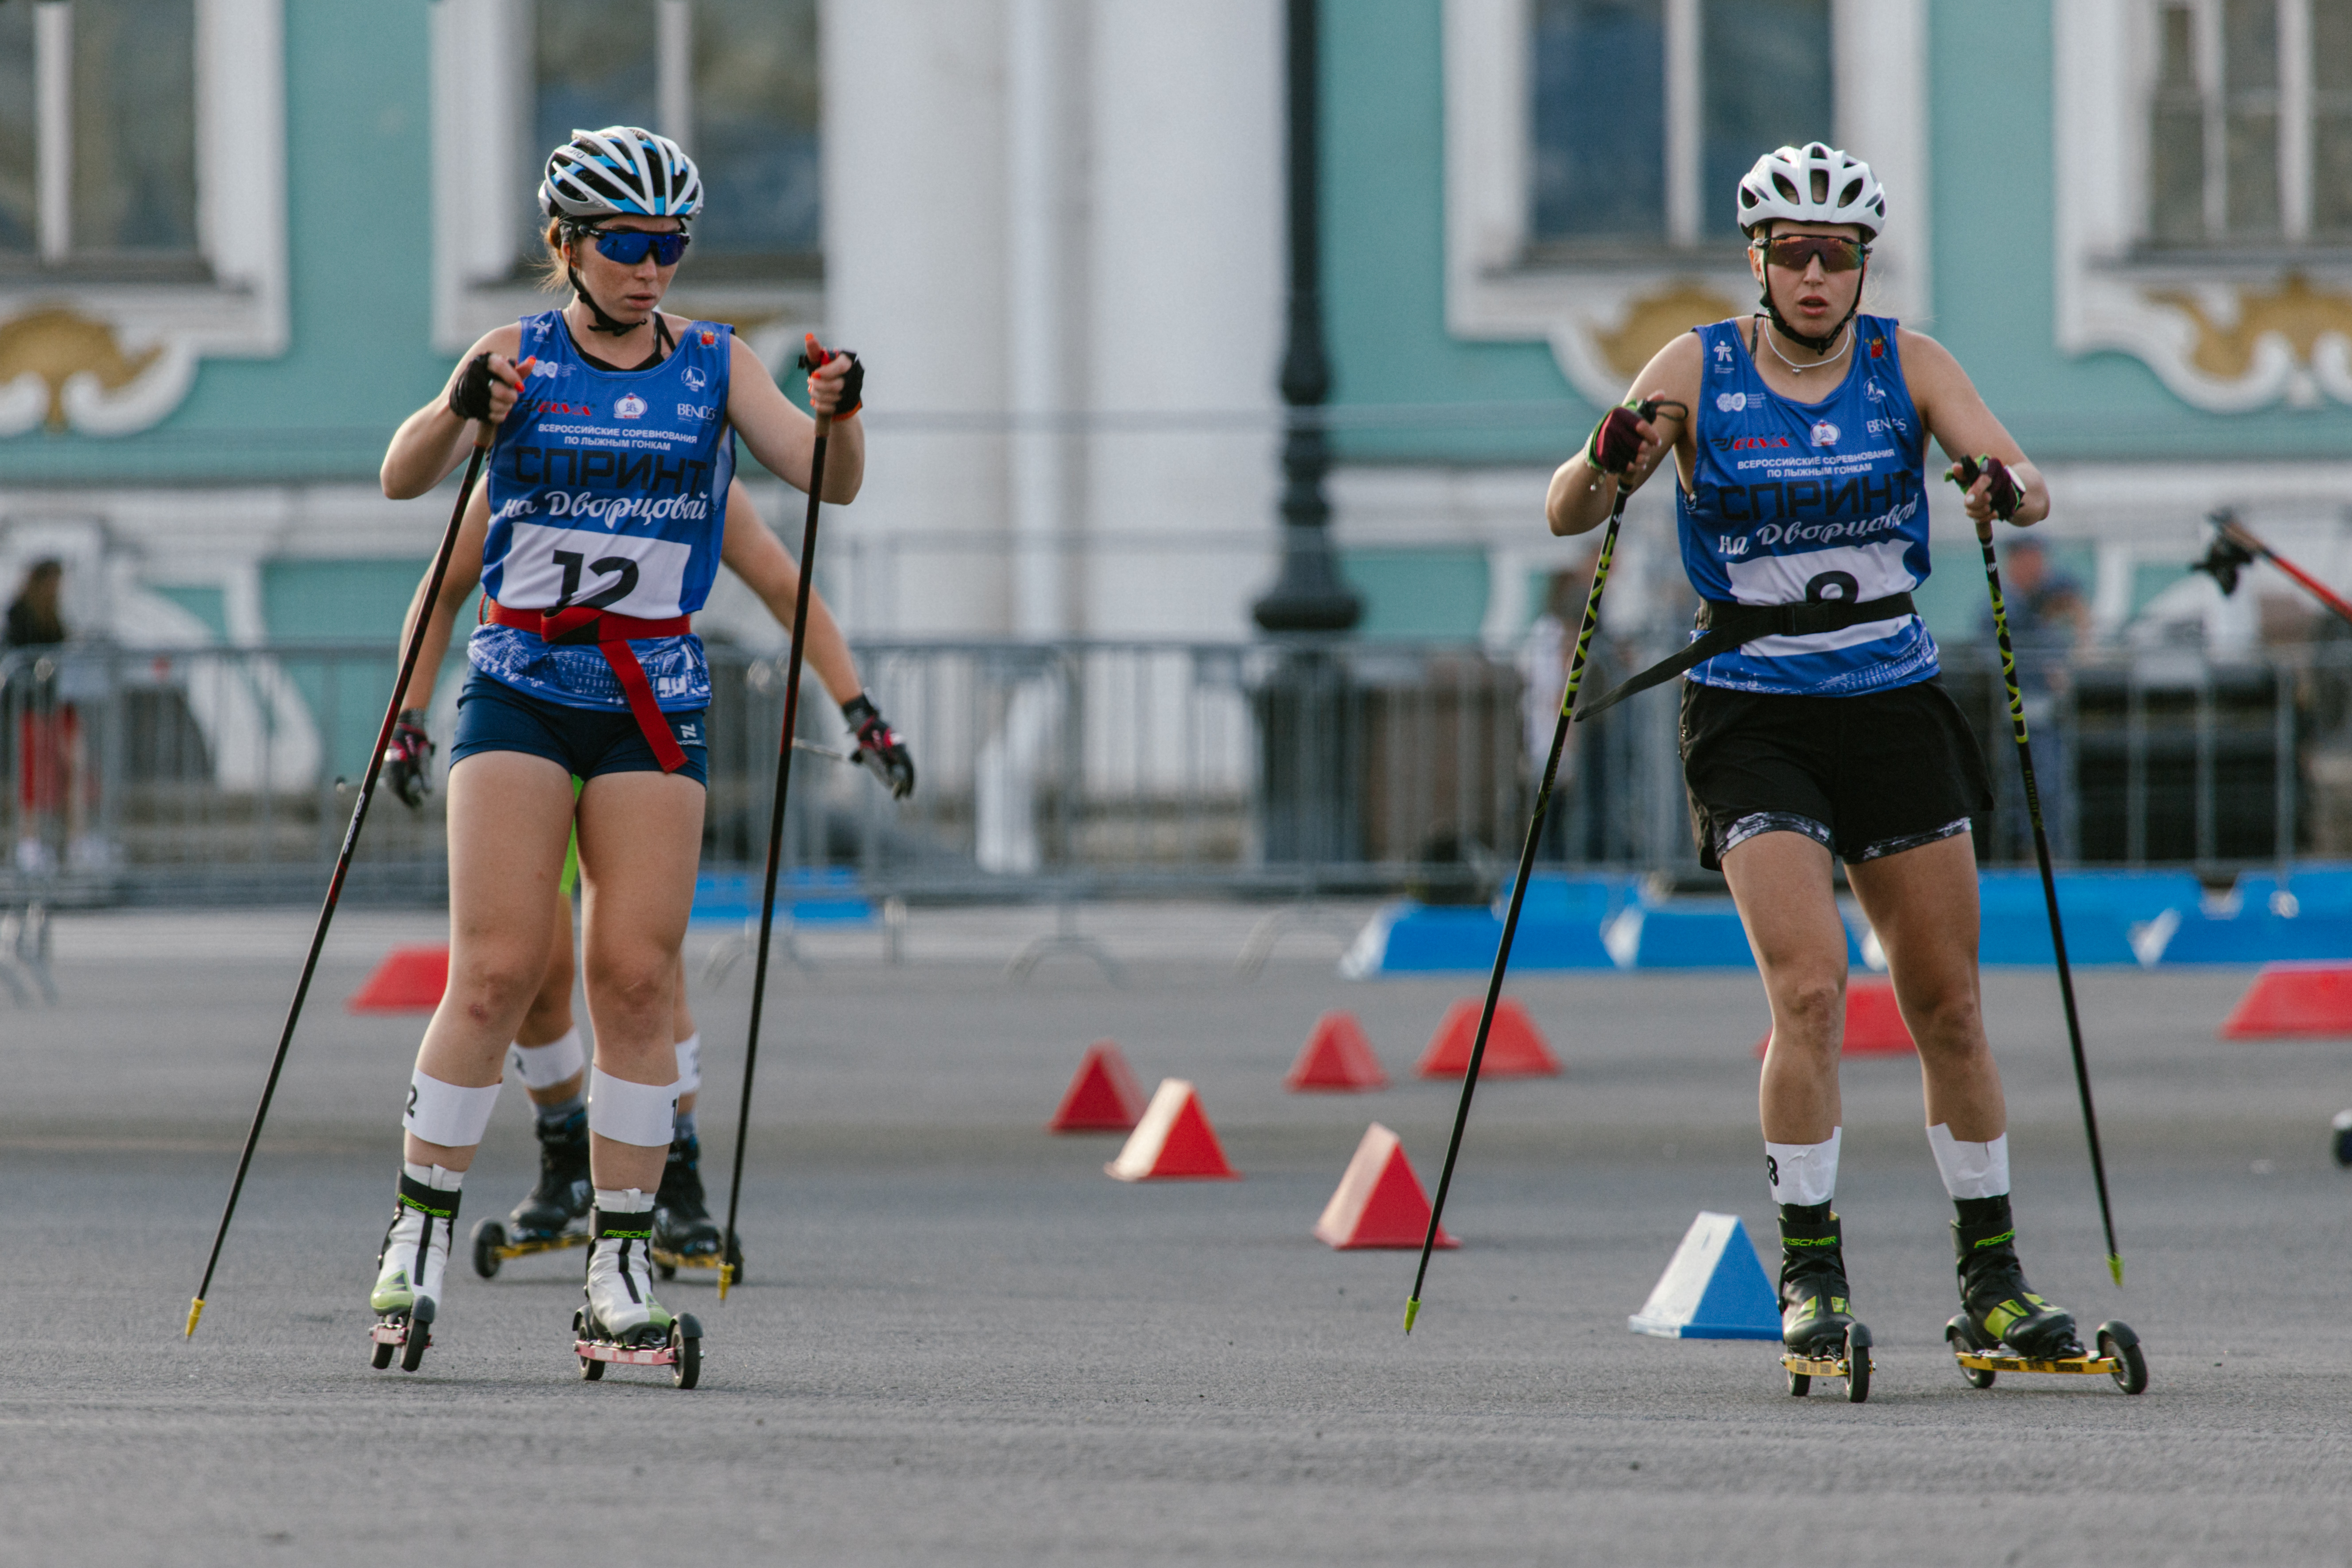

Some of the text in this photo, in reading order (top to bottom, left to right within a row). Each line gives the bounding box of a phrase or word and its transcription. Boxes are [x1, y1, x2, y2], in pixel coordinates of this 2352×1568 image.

[677, 403, 717, 420] BENDES
[538, 423, 698, 443] ВСЕРОССИЙСКИЕ СОРЕВНОВАНИЯ
[1866, 416, 1907, 434] BENES
[564, 436, 671, 451] ПО ЛЫЖНЫМ ГОНКАМ
[1737, 448, 1895, 470] ВСЕРОССИЙСКИЕ СОРЕВНОВАНИЯ
[515, 445, 707, 497] СПРИНТ
[1767, 463, 1873, 477] ПО ЛЫЖНЫМ ГОНКАМ
[1718, 470, 1913, 520] СПРИНТ
[501, 490, 708, 530] на Дворцовой
[1718, 535, 1749, 555] на
[552, 549, 639, 609] 12
[1766, 1154, 1779, 1187] 8
[398, 1193, 451, 1218] FISCHER
[602, 1229, 652, 1238] FISCHE
[1782, 1235, 1837, 1246] FISCHER
